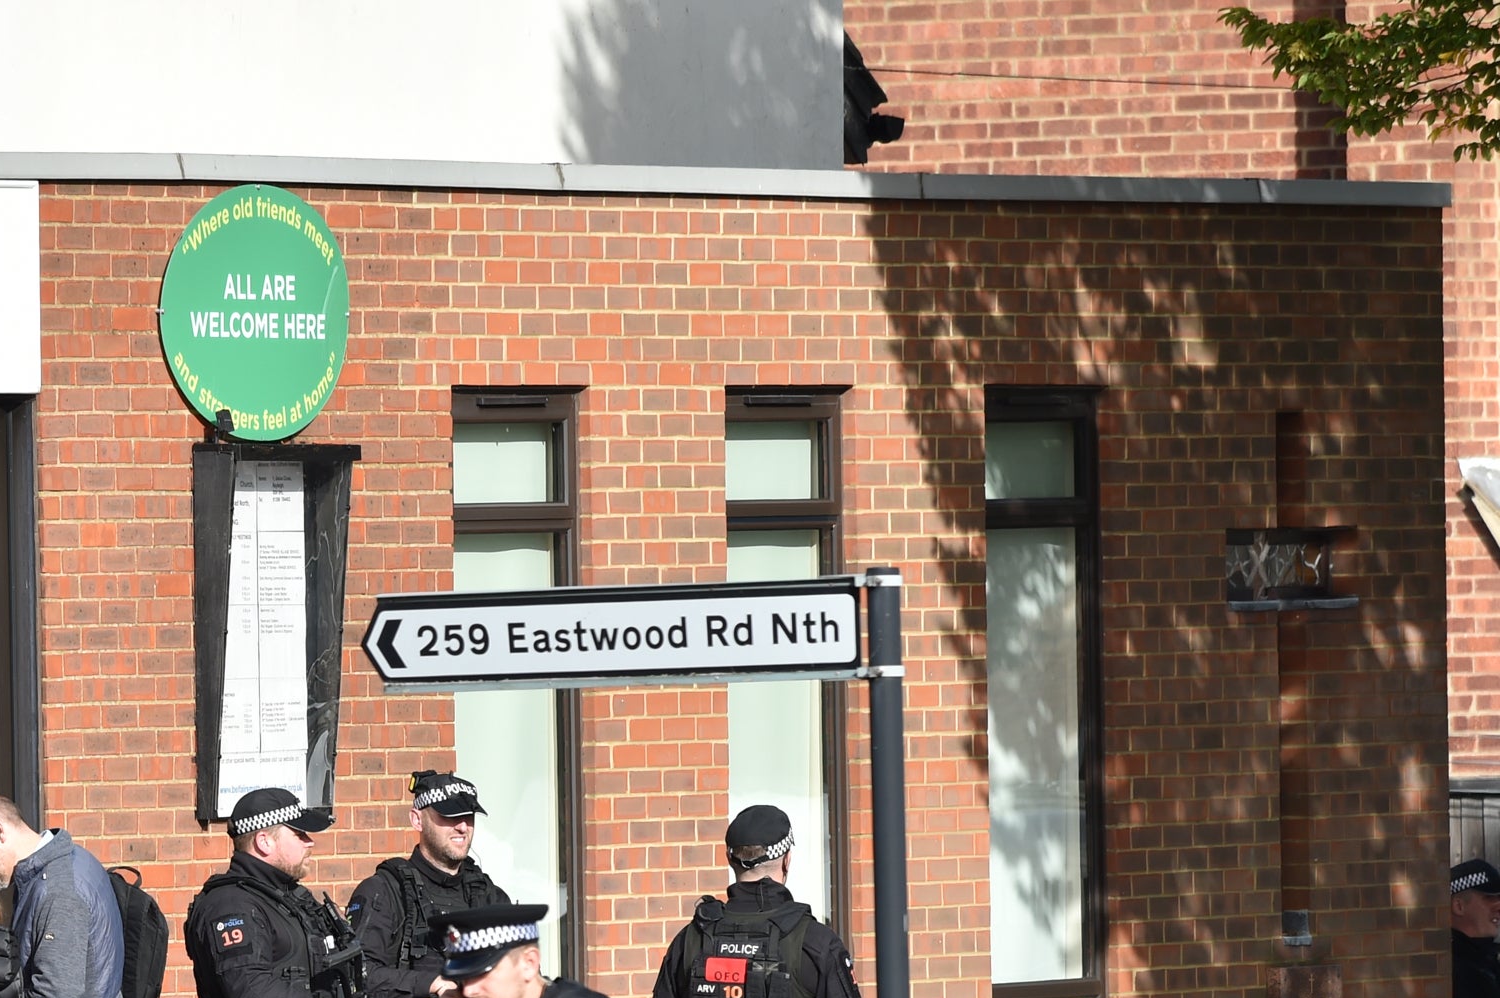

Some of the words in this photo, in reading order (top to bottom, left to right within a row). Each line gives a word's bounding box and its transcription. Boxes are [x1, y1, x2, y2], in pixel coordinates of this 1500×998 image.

[232, 196, 253, 221] old
[256, 196, 302, 230] friends
[304, 220, 334, 266] meet
[223, 273, 257, 301] ALL
[260, 274, 297, 301] ARE
[190, 311, 279, 339] WELCOME
[283, 313, 326, 340] HERE
[174, 352, 199, 393] and
[263, 405, 287, 430] feel
[290, 400, 303, 424] at
[417, 623, 490, 657] 259
[507, 616, 688, 654] Eastwood
[706, 613, 754, 648] Rd
[771, 610, 841, 645] Nth
[221, 928, 244, 947] 19
[720, 943, 759, 955] POLICE
[697, 984, 716, 993] ARV
[714, 970, 740, 982] OFC
